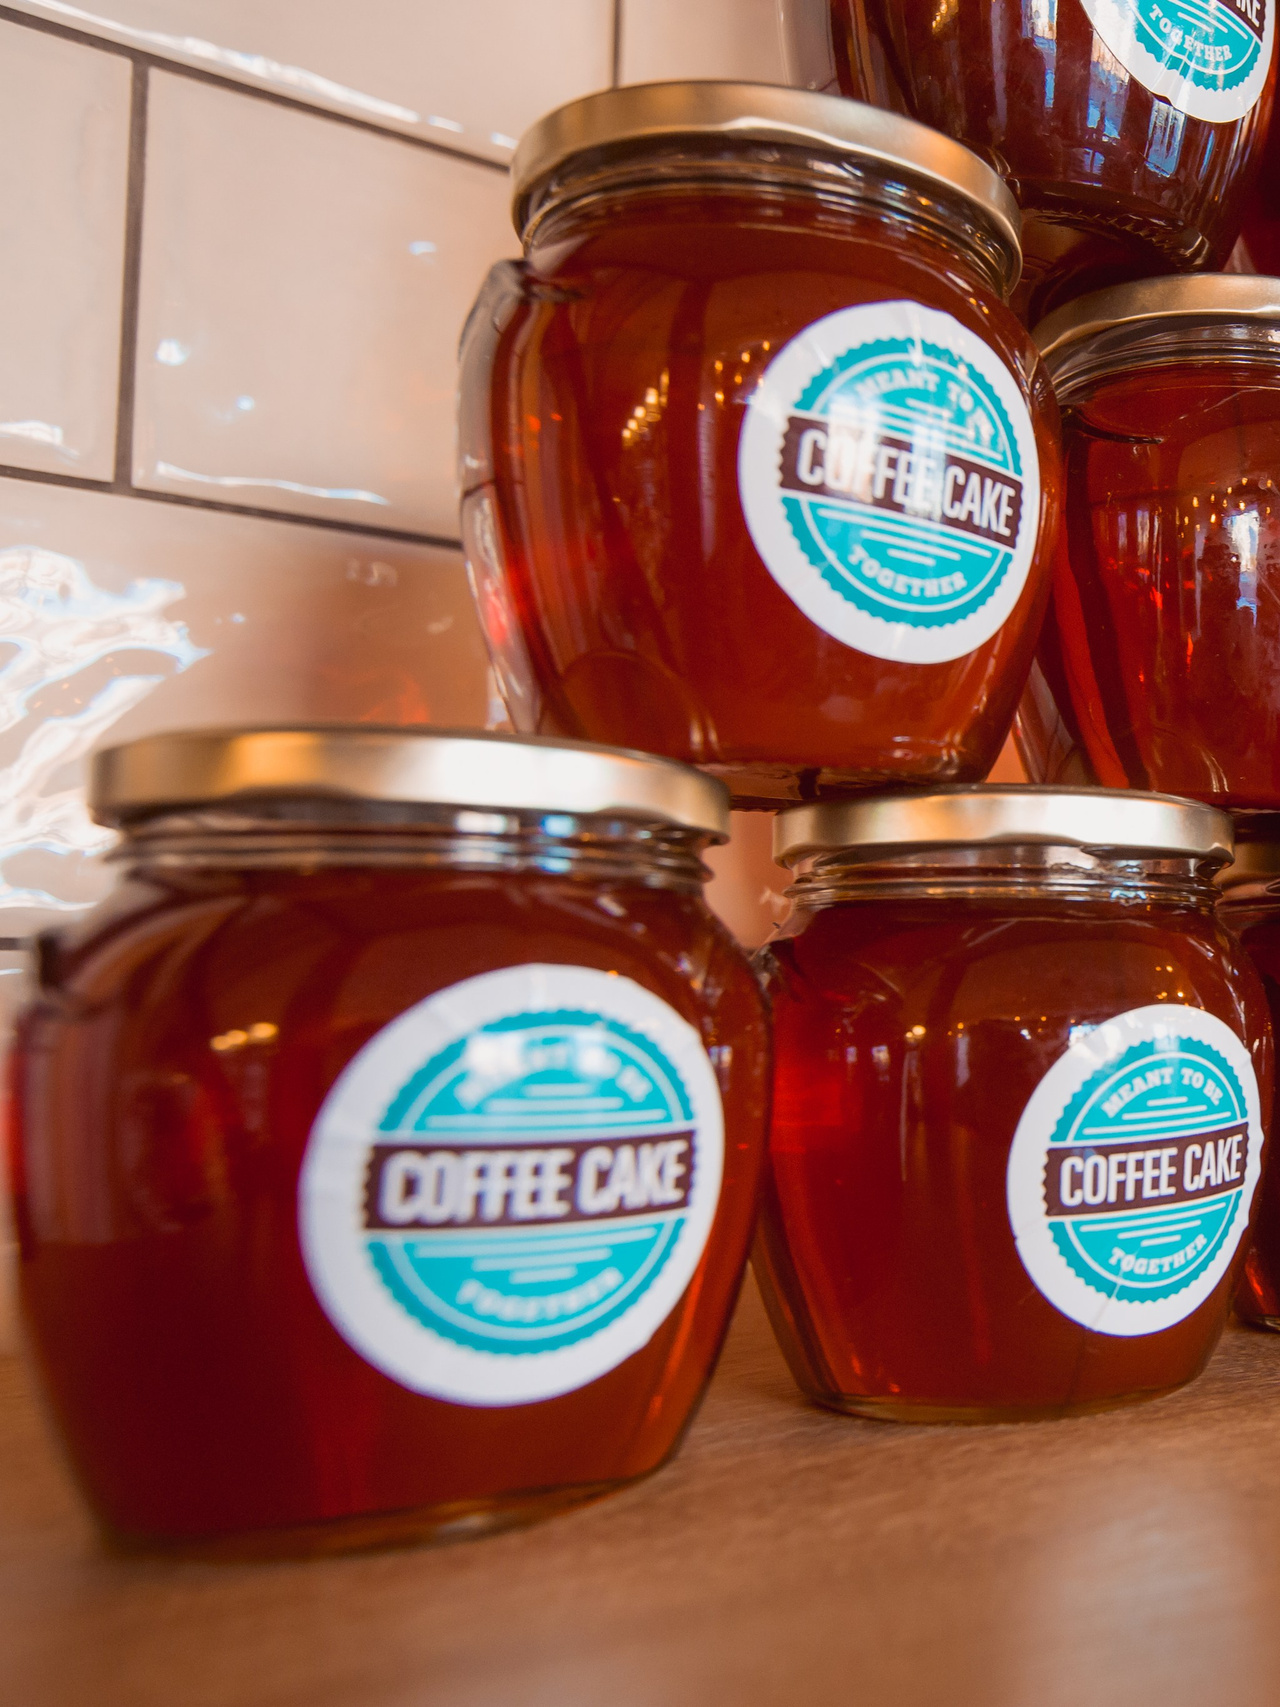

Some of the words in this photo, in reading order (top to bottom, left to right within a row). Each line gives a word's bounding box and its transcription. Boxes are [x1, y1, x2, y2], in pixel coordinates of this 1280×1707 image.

[1149, 4, 1232, 61] TOGETHER
[947, 380, 974, 412] TO
[797, 428, 938, 512] COFFEE
[943, 464, 1016, 537] CAKE
[849, 544, 968, 598] TOGETHER
[1101, 1067, 1174, 1118] MEANT
[1181, 1068, 1202, 1089] TO
[1202, 1079, 1223, 1105] BE
[377, 1148, 575, 1226] COFFEE
[574, 1139, 689, 1216] CAKE
[1060, 1147, 1178, 1207] COFFEE
[1183, 1133, 1243, 1192] CAKE
[1108, 1234, 1208, 1275] TOGETHER
